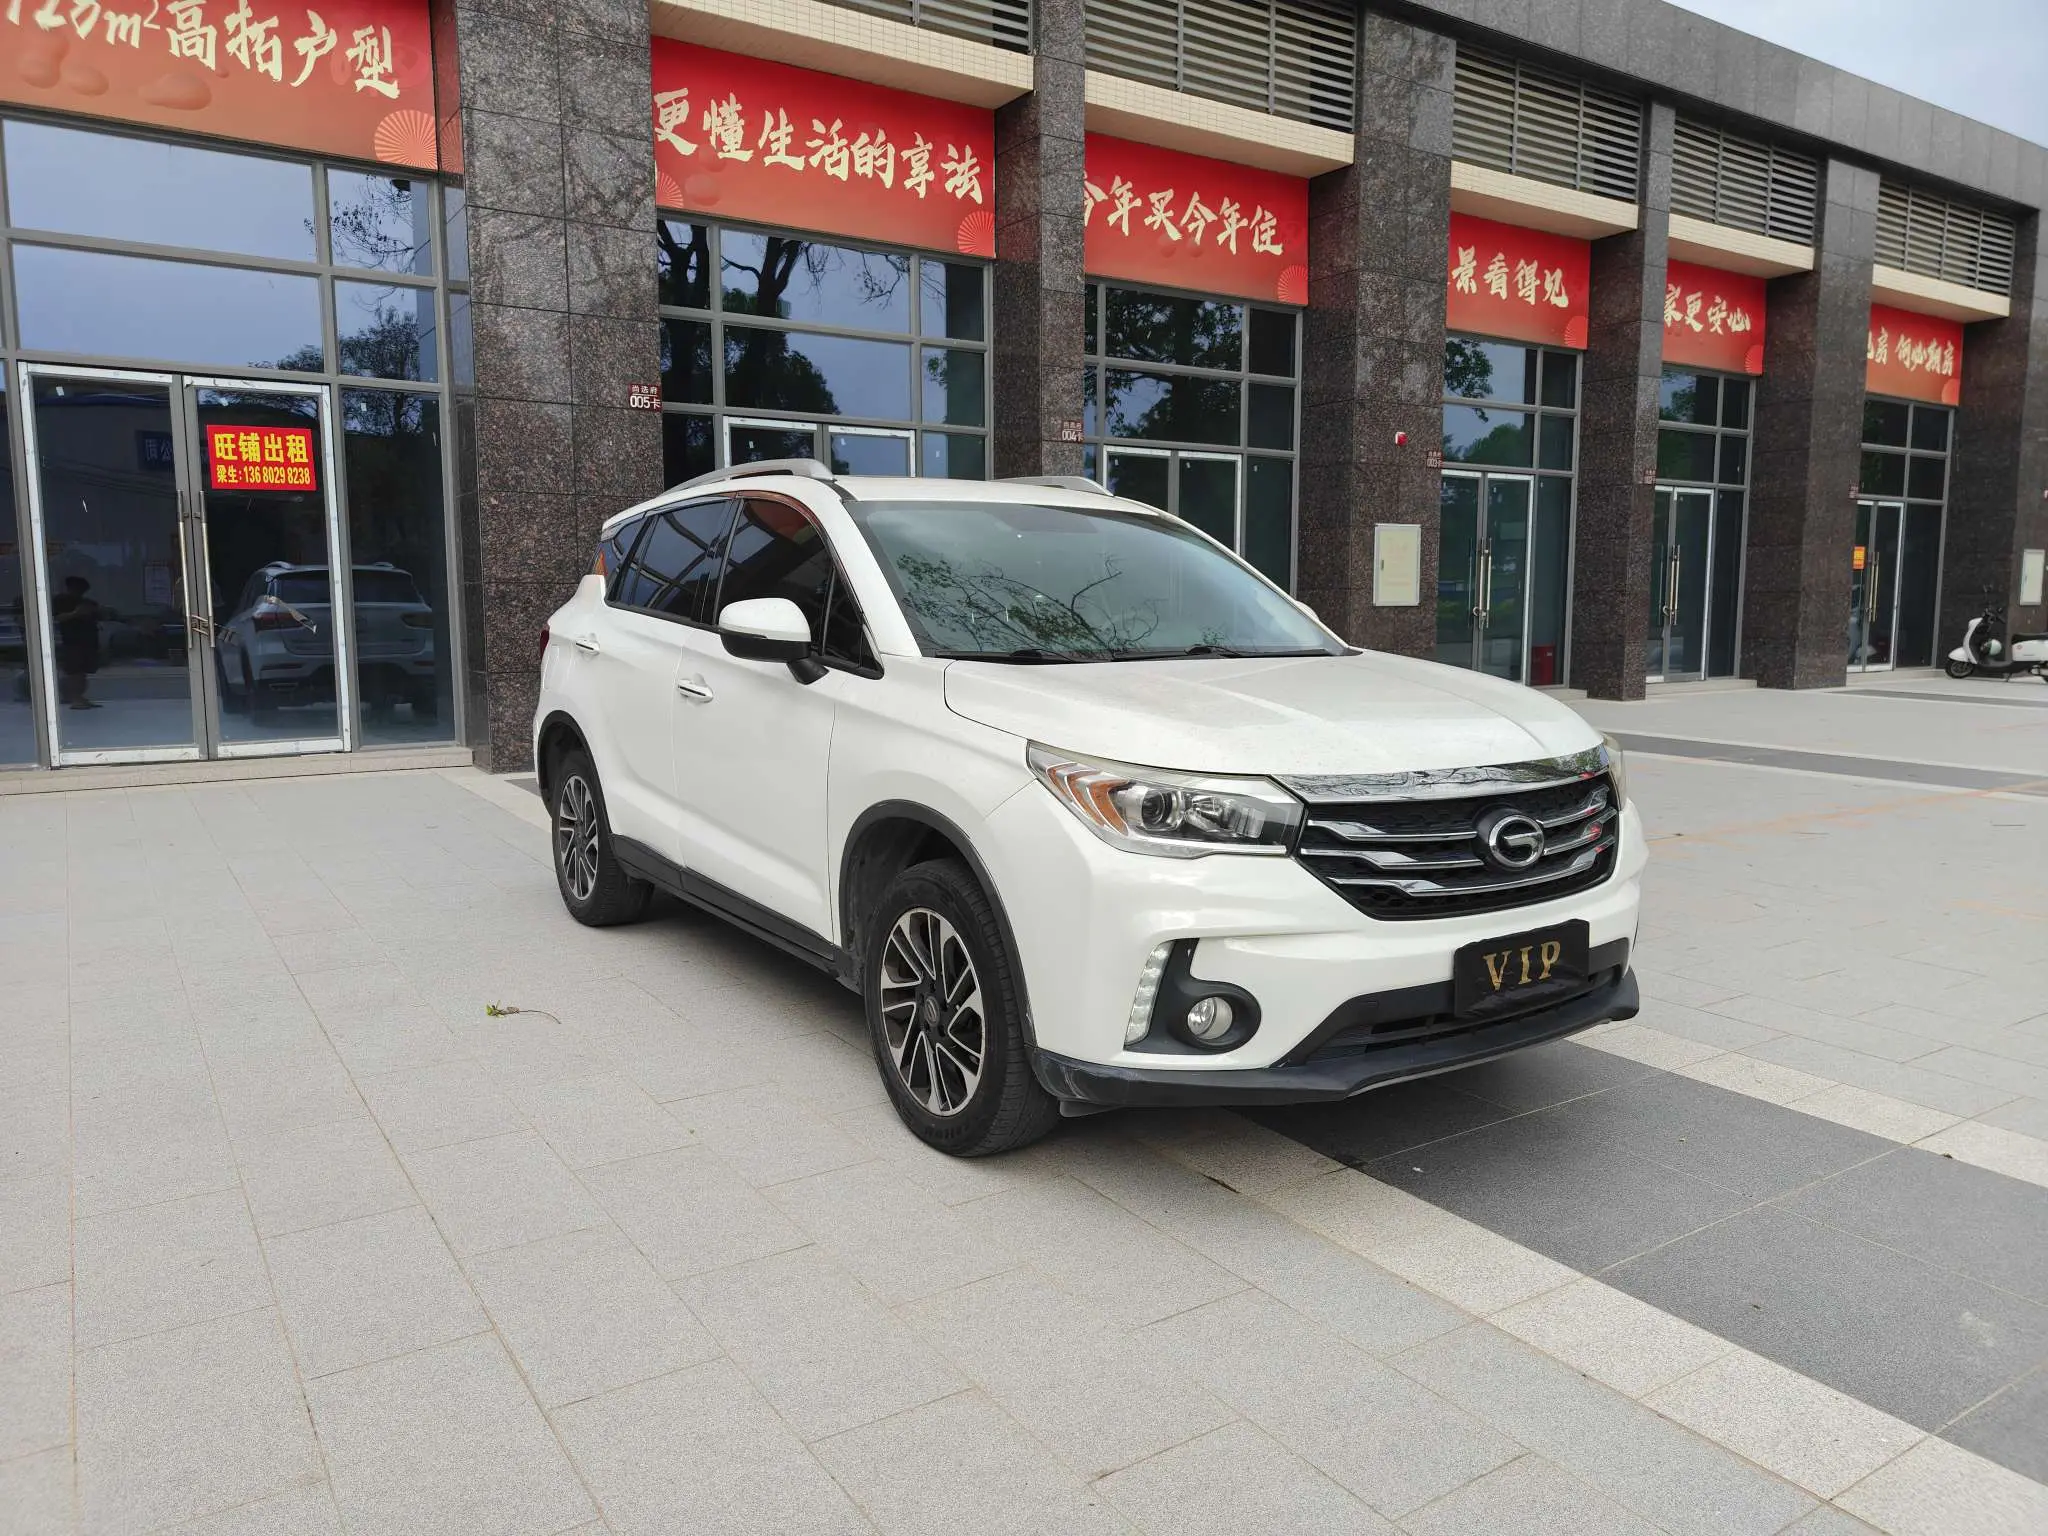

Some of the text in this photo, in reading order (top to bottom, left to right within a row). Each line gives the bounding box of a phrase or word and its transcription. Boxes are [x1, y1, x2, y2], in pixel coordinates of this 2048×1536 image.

[653, 87, 984, 205] 更懂生活的享法
[1083, 170, 1284, 256] 今年买今年住
[629, 395, 661, 410] 005卡
[214, 432, 309, 463] 旺铺出租
[1482, 941, 1561, 992] VIP
